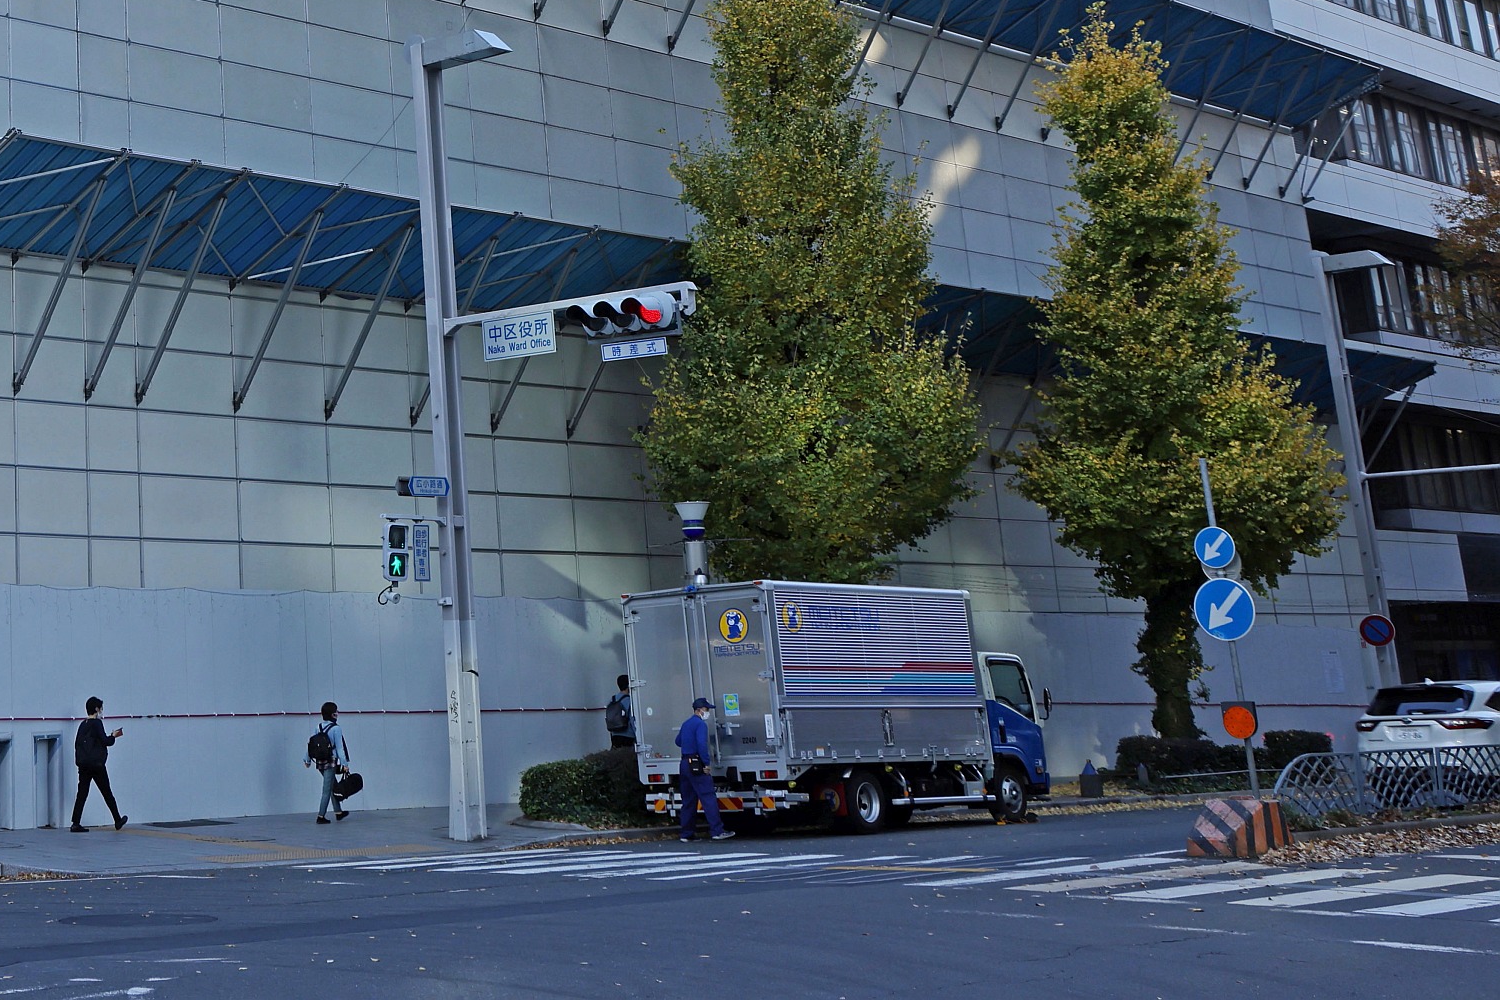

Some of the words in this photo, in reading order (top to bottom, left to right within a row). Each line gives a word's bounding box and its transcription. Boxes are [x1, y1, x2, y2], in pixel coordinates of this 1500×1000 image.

[488, 318, 549, 342] 中区役所
[488, 345, 506, 355] Naka
[509, 341, 527, 352] Ward
[530, 339, 551, 349] Office
[611, 342, 657, 357] 時差式
[713, 643, 760, 653] MEITETSU
